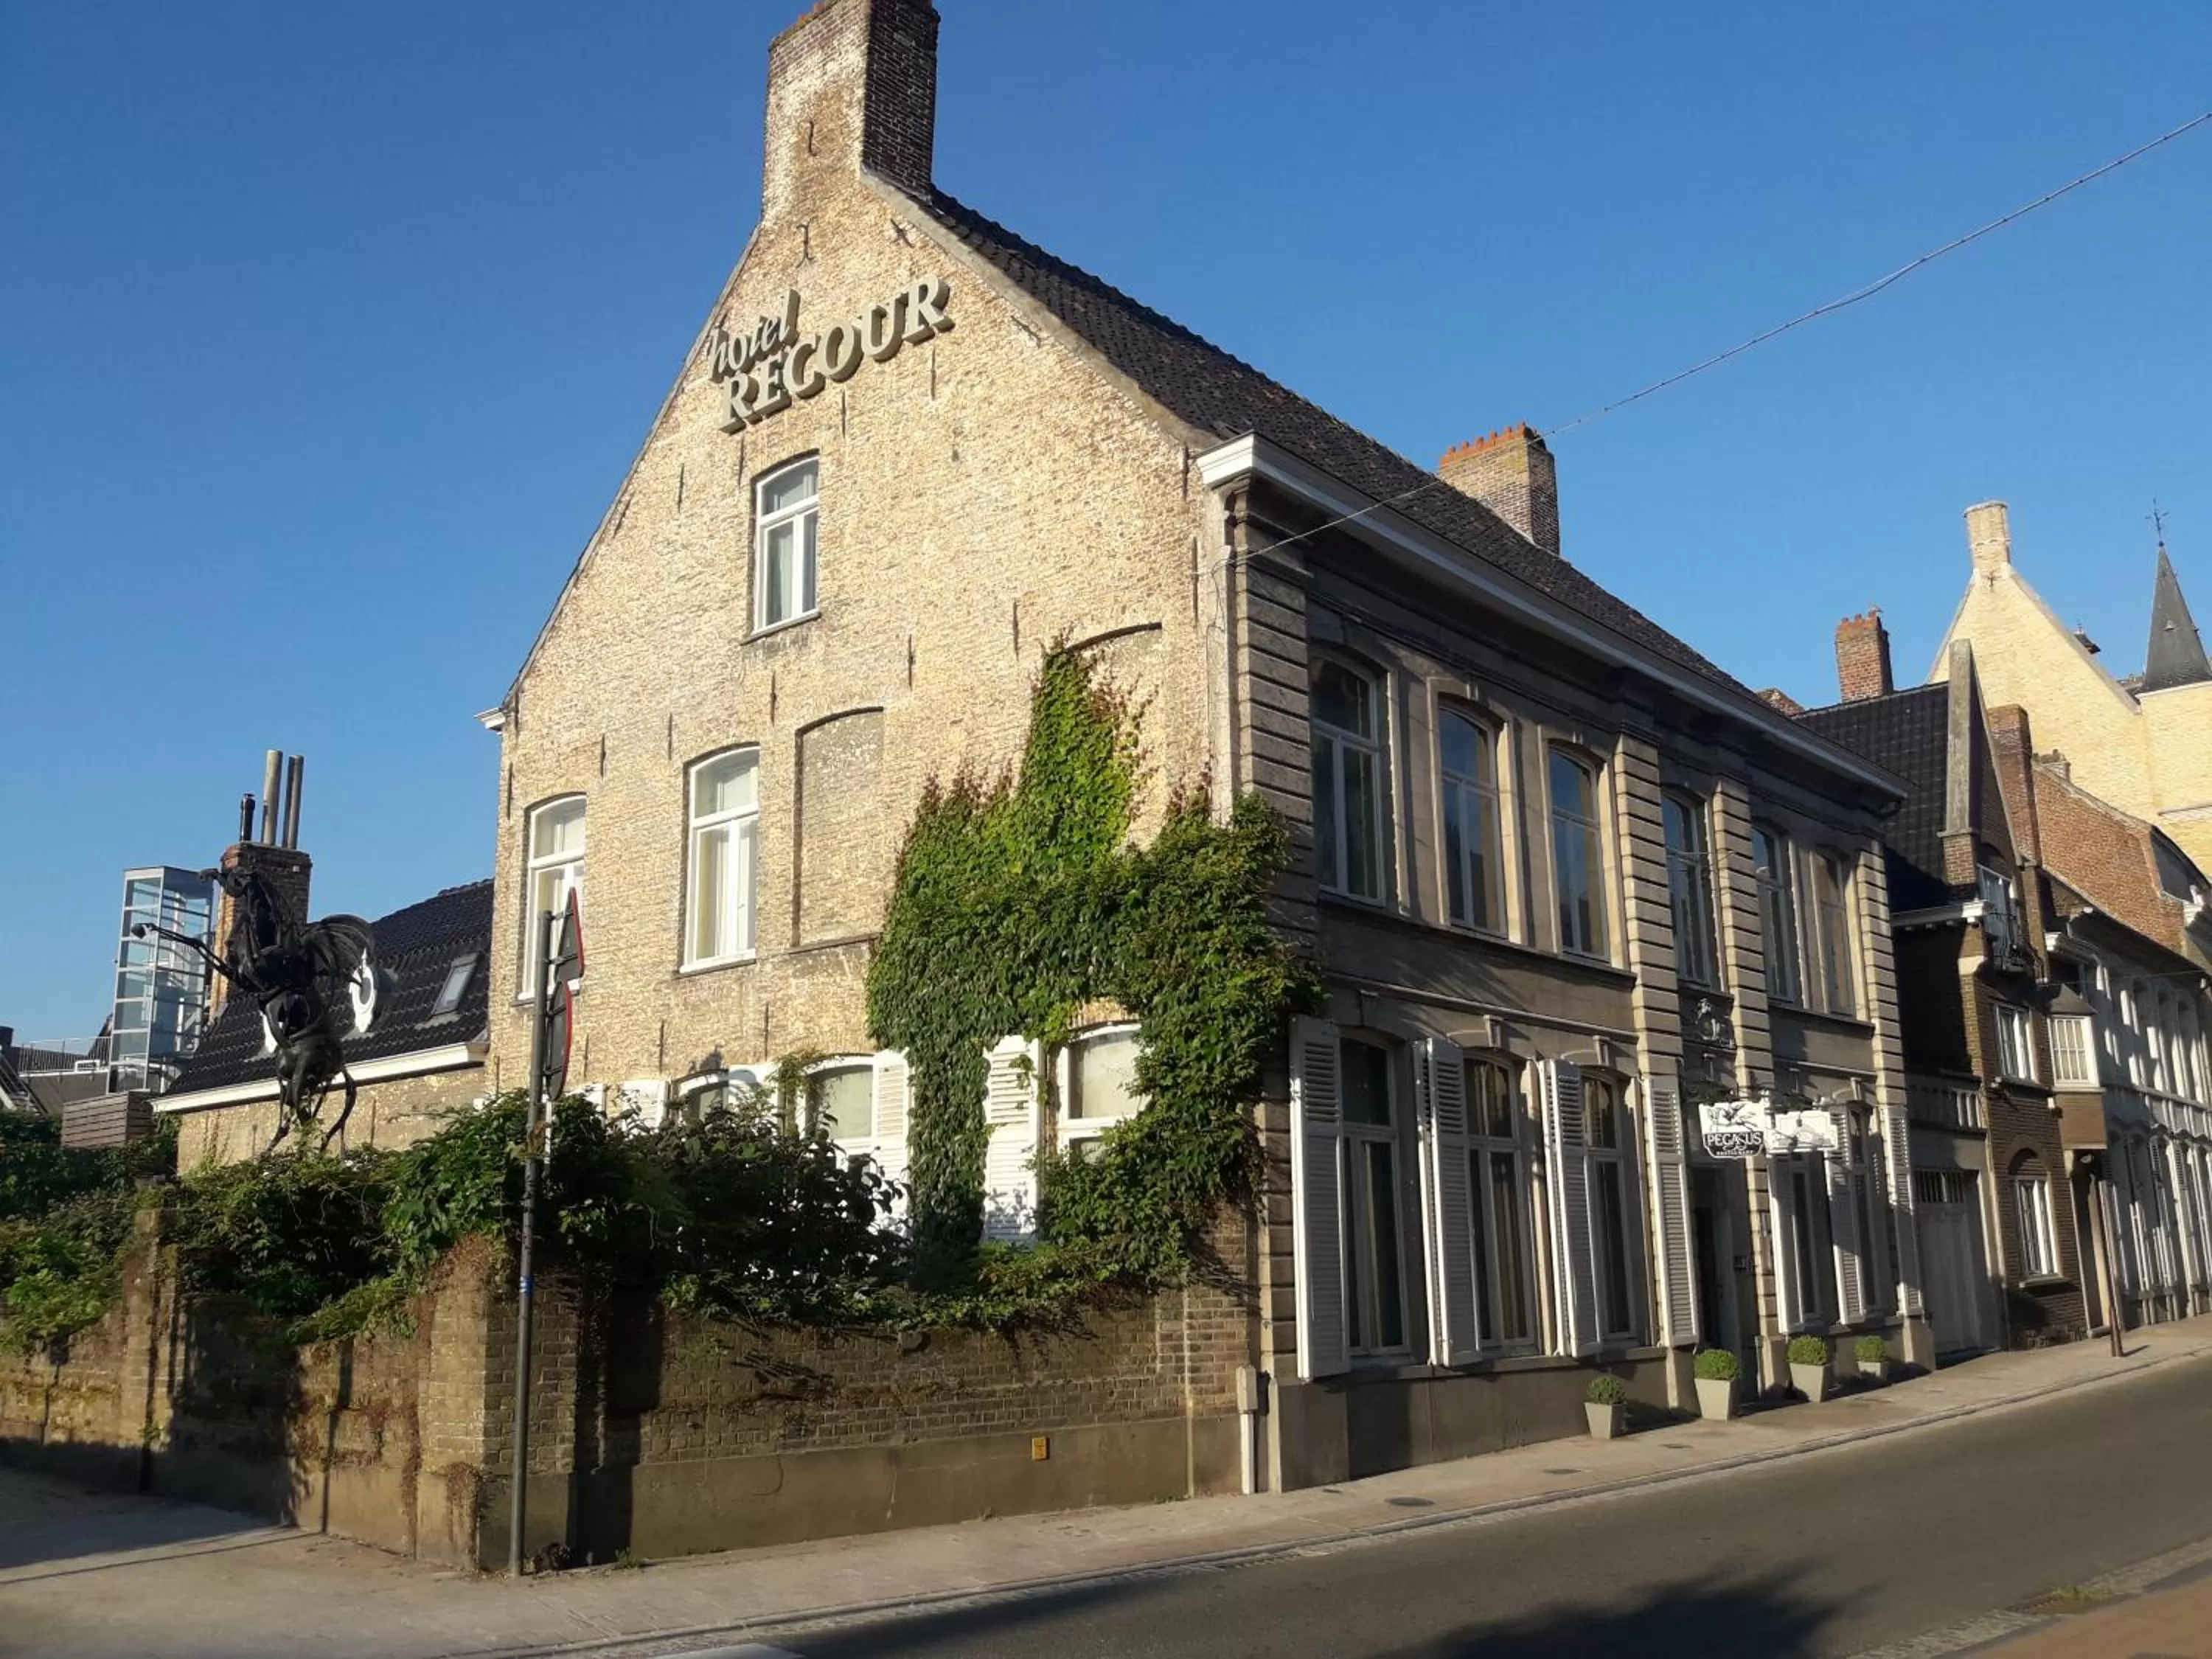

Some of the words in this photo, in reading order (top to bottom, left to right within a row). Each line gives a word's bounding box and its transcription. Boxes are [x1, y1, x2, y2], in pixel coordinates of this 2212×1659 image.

[709, 288, 800, 381] hotel
[719, 275, 954, 435] RECOUR
[1707, 1132, 1761, 1147] PEGASUS
